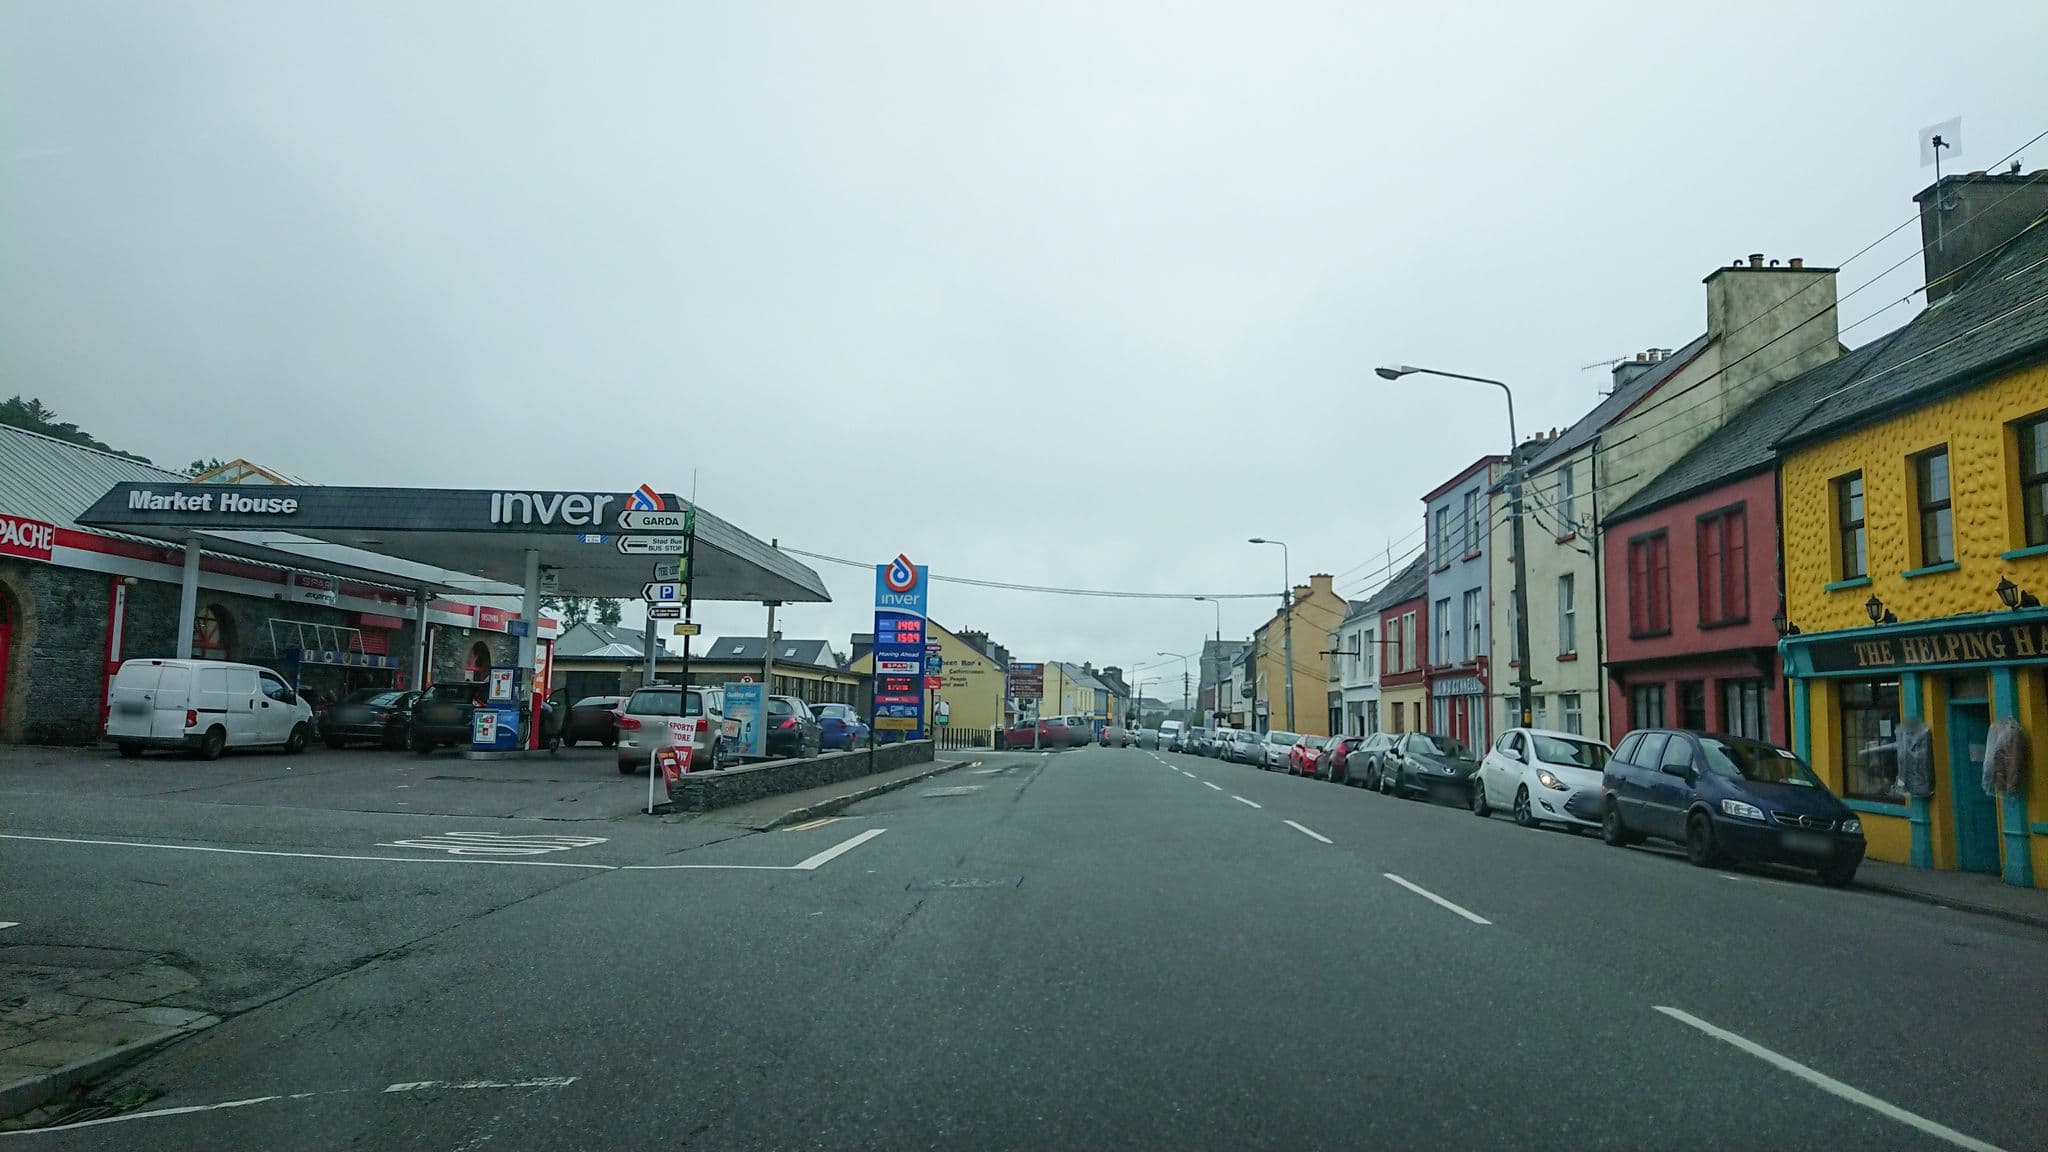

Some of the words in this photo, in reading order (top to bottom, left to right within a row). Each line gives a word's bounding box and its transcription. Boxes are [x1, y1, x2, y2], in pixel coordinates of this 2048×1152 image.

[129, 489, 212, 511] Market
[220, 492, 298, 514] House
[490, 492, 613, 526] inver
[643, 516, 679, 526] GARDA
[662, 586, 671, 597] P
[881, 593, 920, 605] inver
[1854, 642, 1894, 666] THE
[1902, 631, 2006, 664] HELPING
[669, 721, 694, 732] SPORTS
[672, 732, 691, 742] TORE
